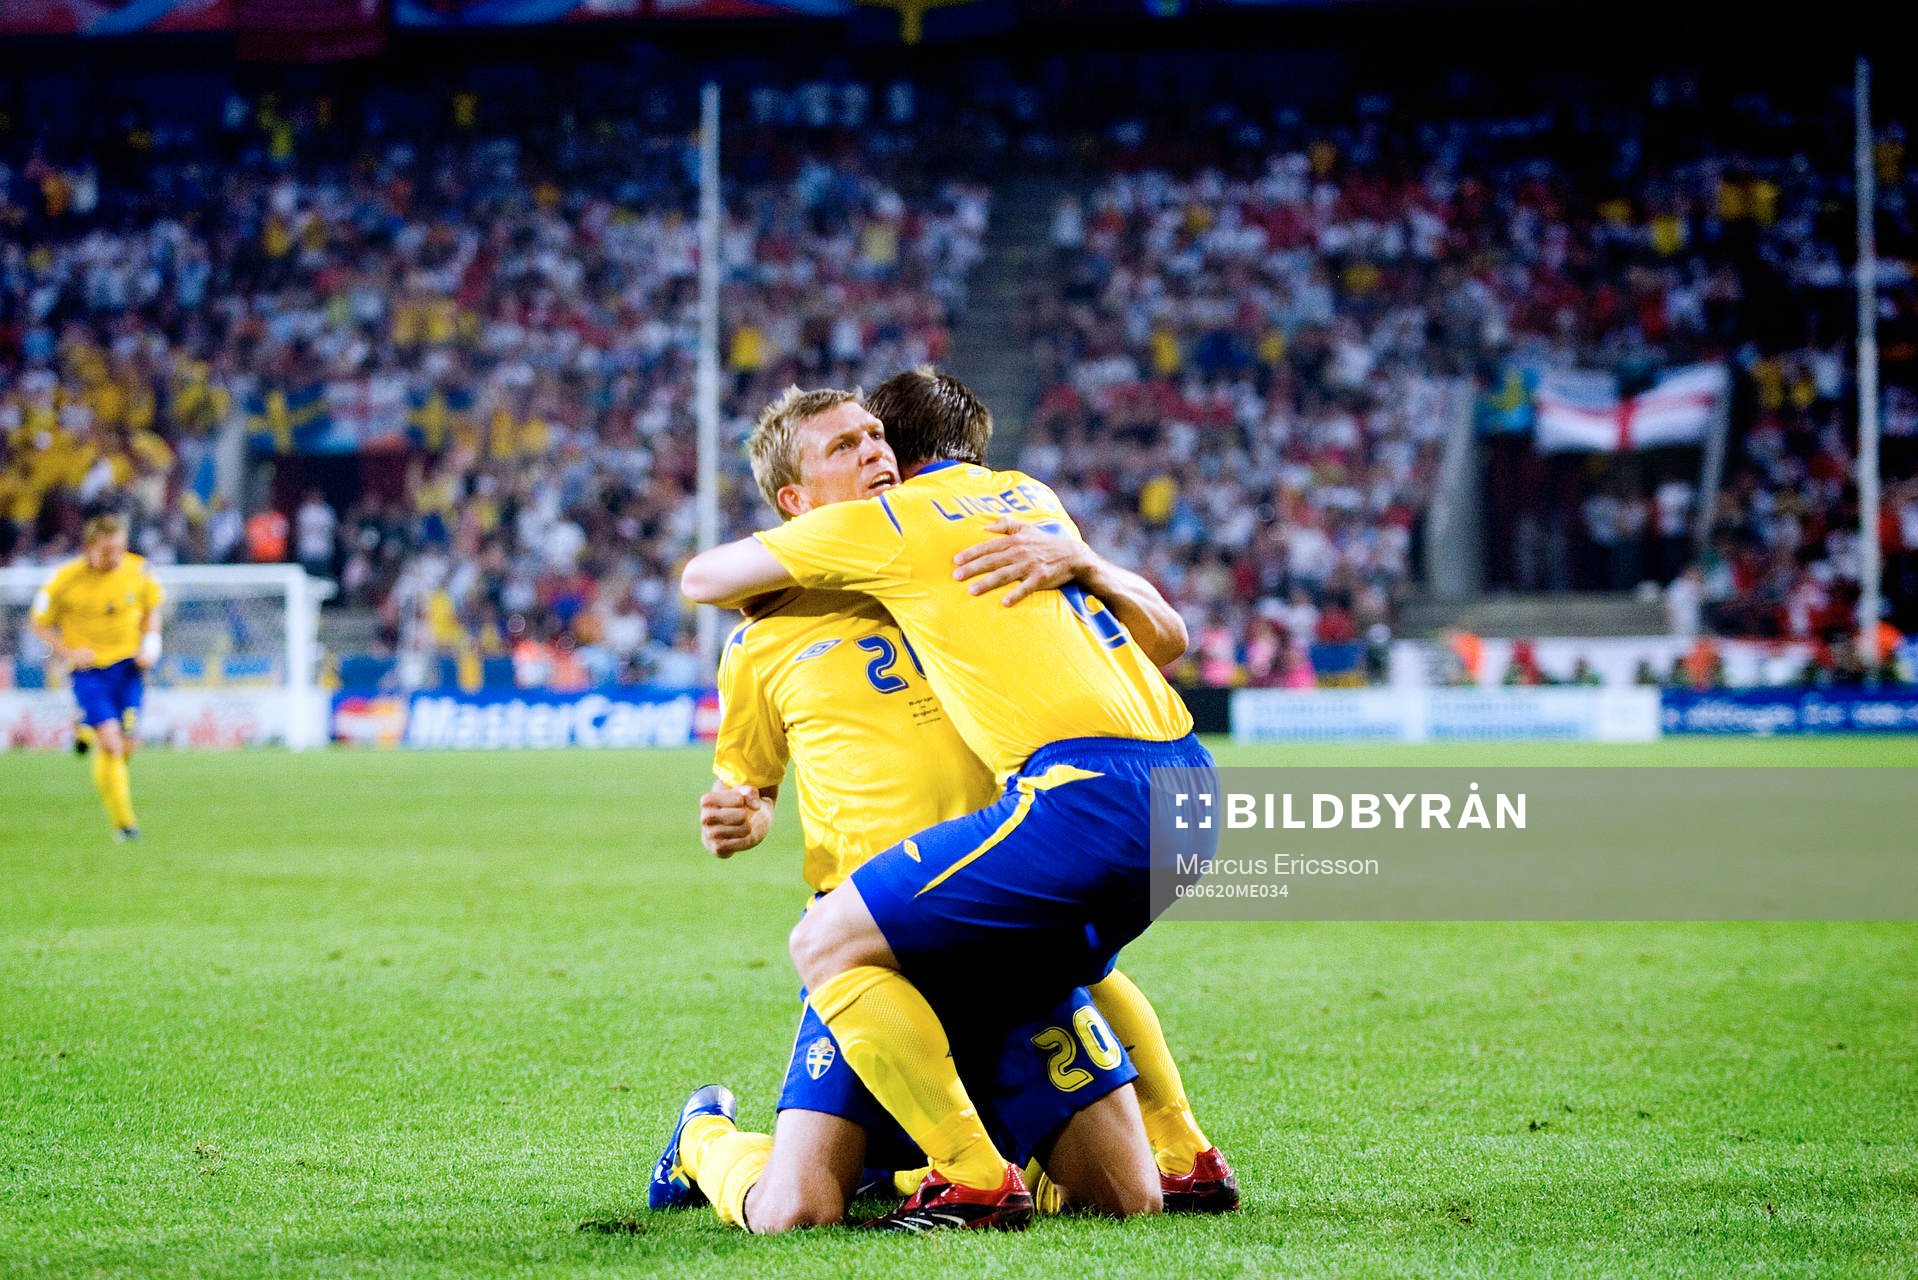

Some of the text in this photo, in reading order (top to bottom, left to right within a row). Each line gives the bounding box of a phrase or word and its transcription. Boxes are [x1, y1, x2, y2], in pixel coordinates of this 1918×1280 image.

[931, 485, 1056, 521] LINDER
[409, 695, 693, 747] MasterCard
[1030, 1005, 1122, 1093] 20
